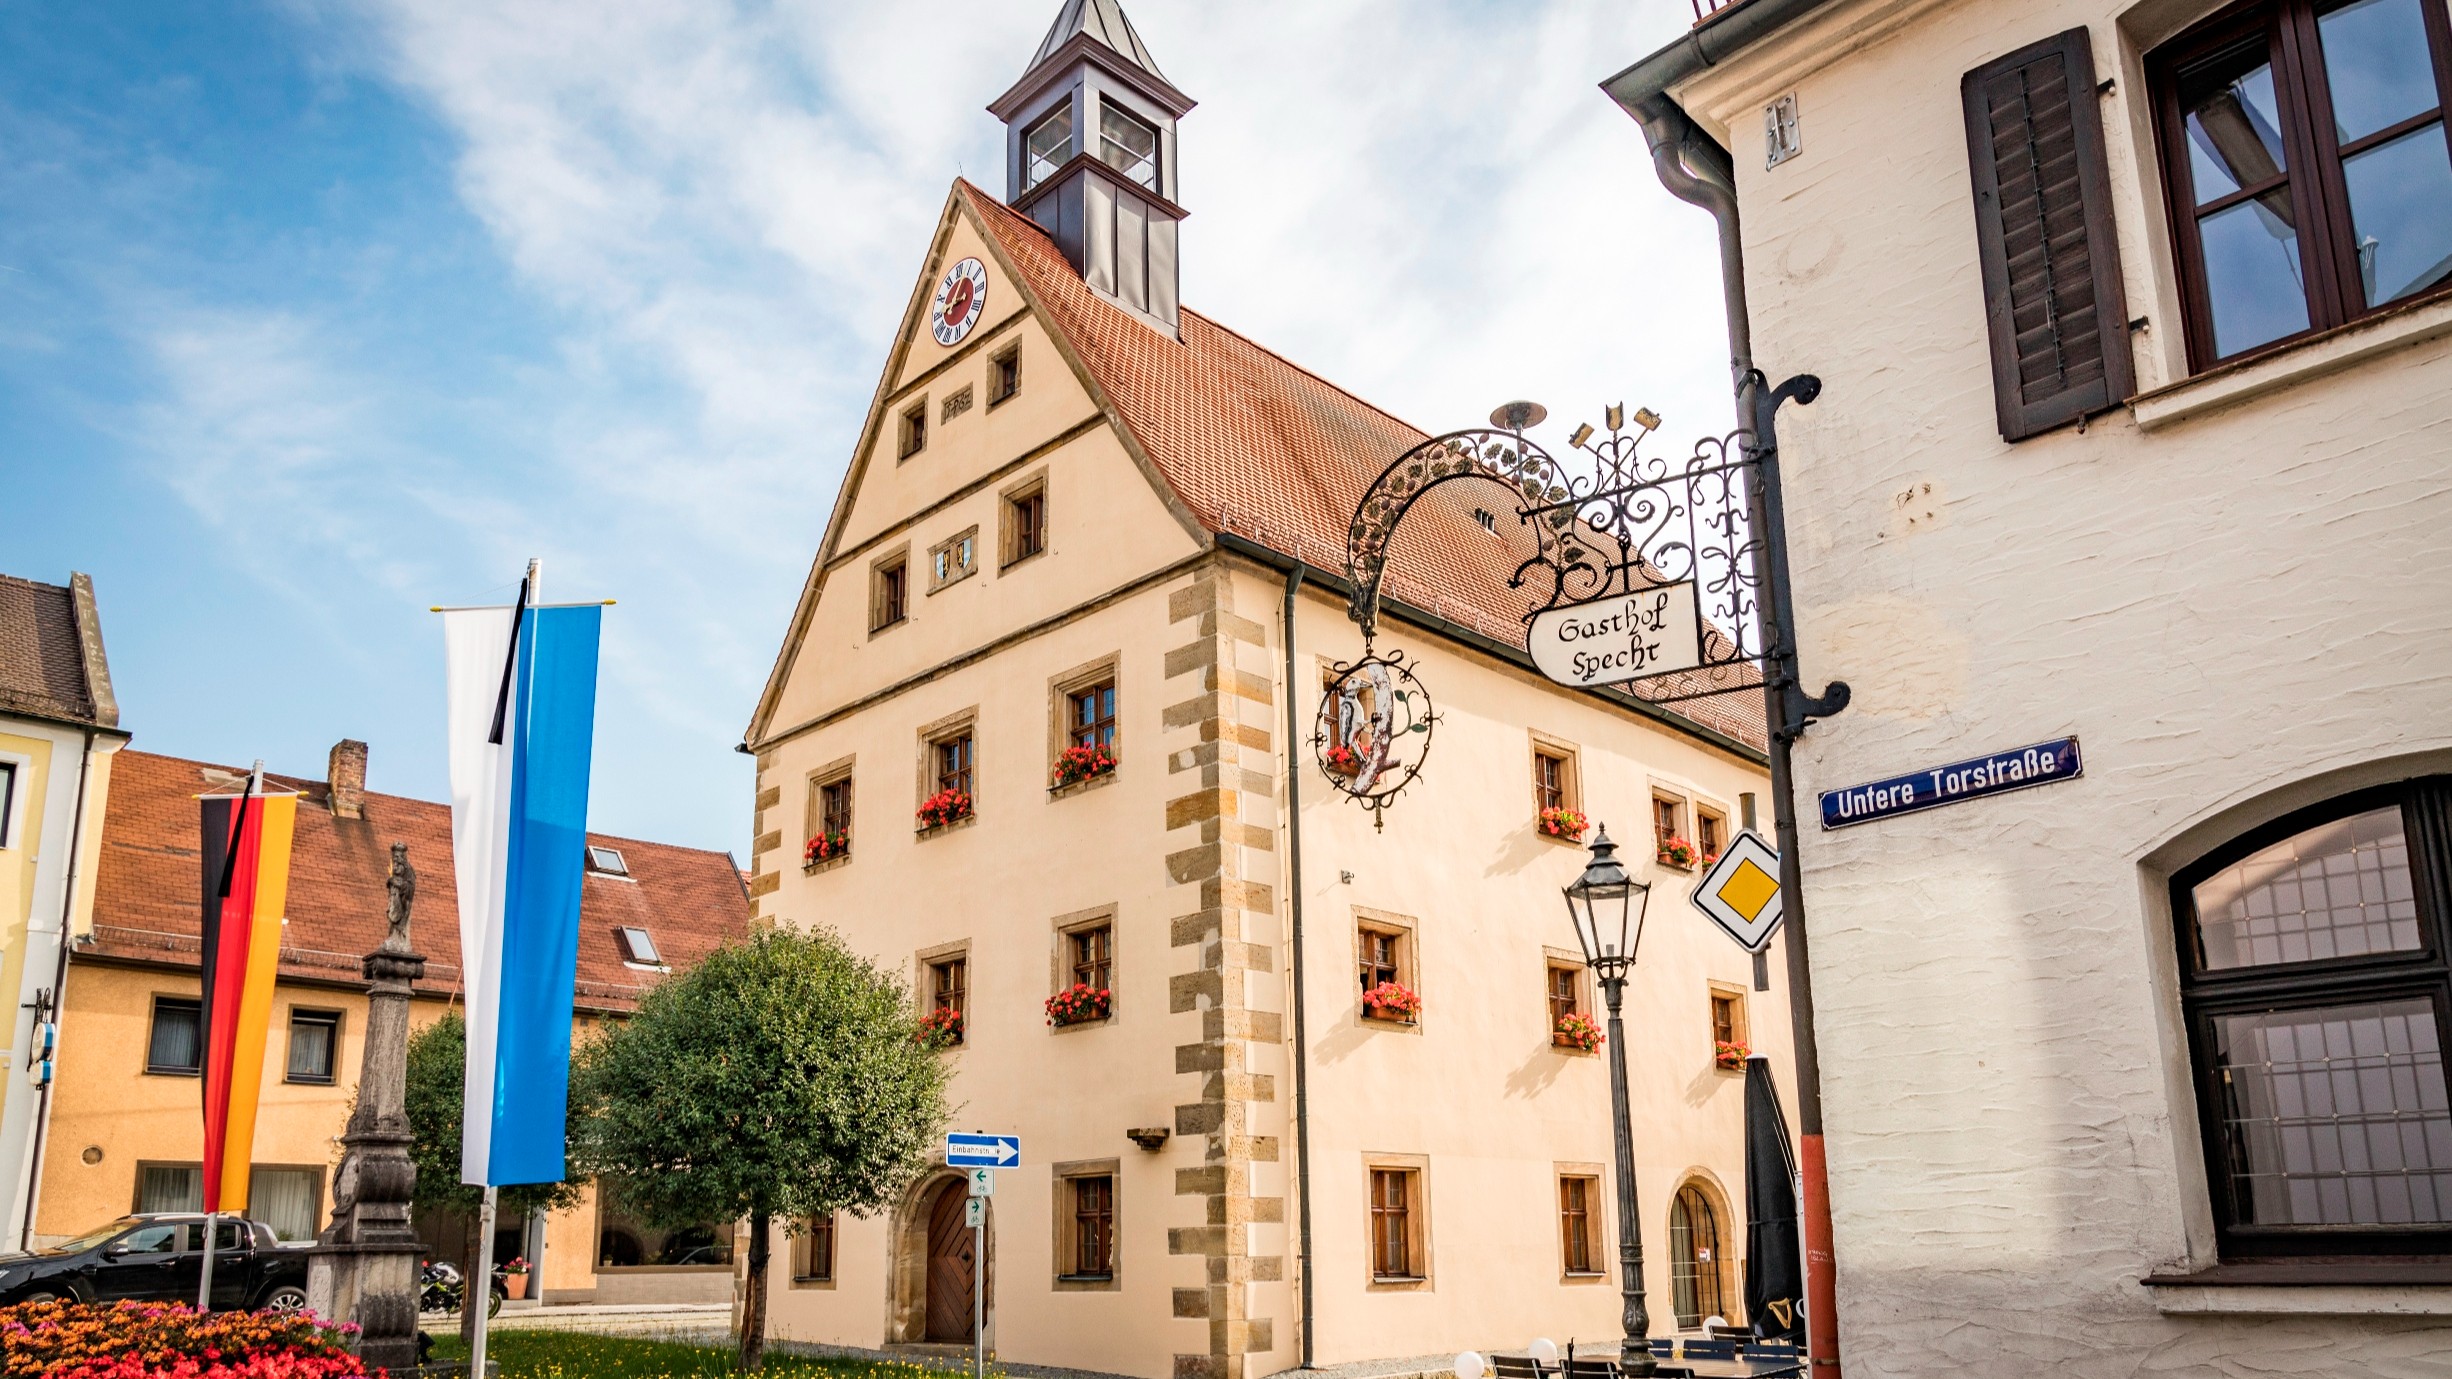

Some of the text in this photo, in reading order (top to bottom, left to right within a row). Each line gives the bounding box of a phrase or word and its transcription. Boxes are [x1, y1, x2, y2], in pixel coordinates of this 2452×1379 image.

[1558, 591, 1668, 642] Gasthof
[1572, 634, 1661, 682] Specht
[1837, 748, 2055, 818] Untere Torstraße
[952, 1144, 1000, 1155] Einbahnste
